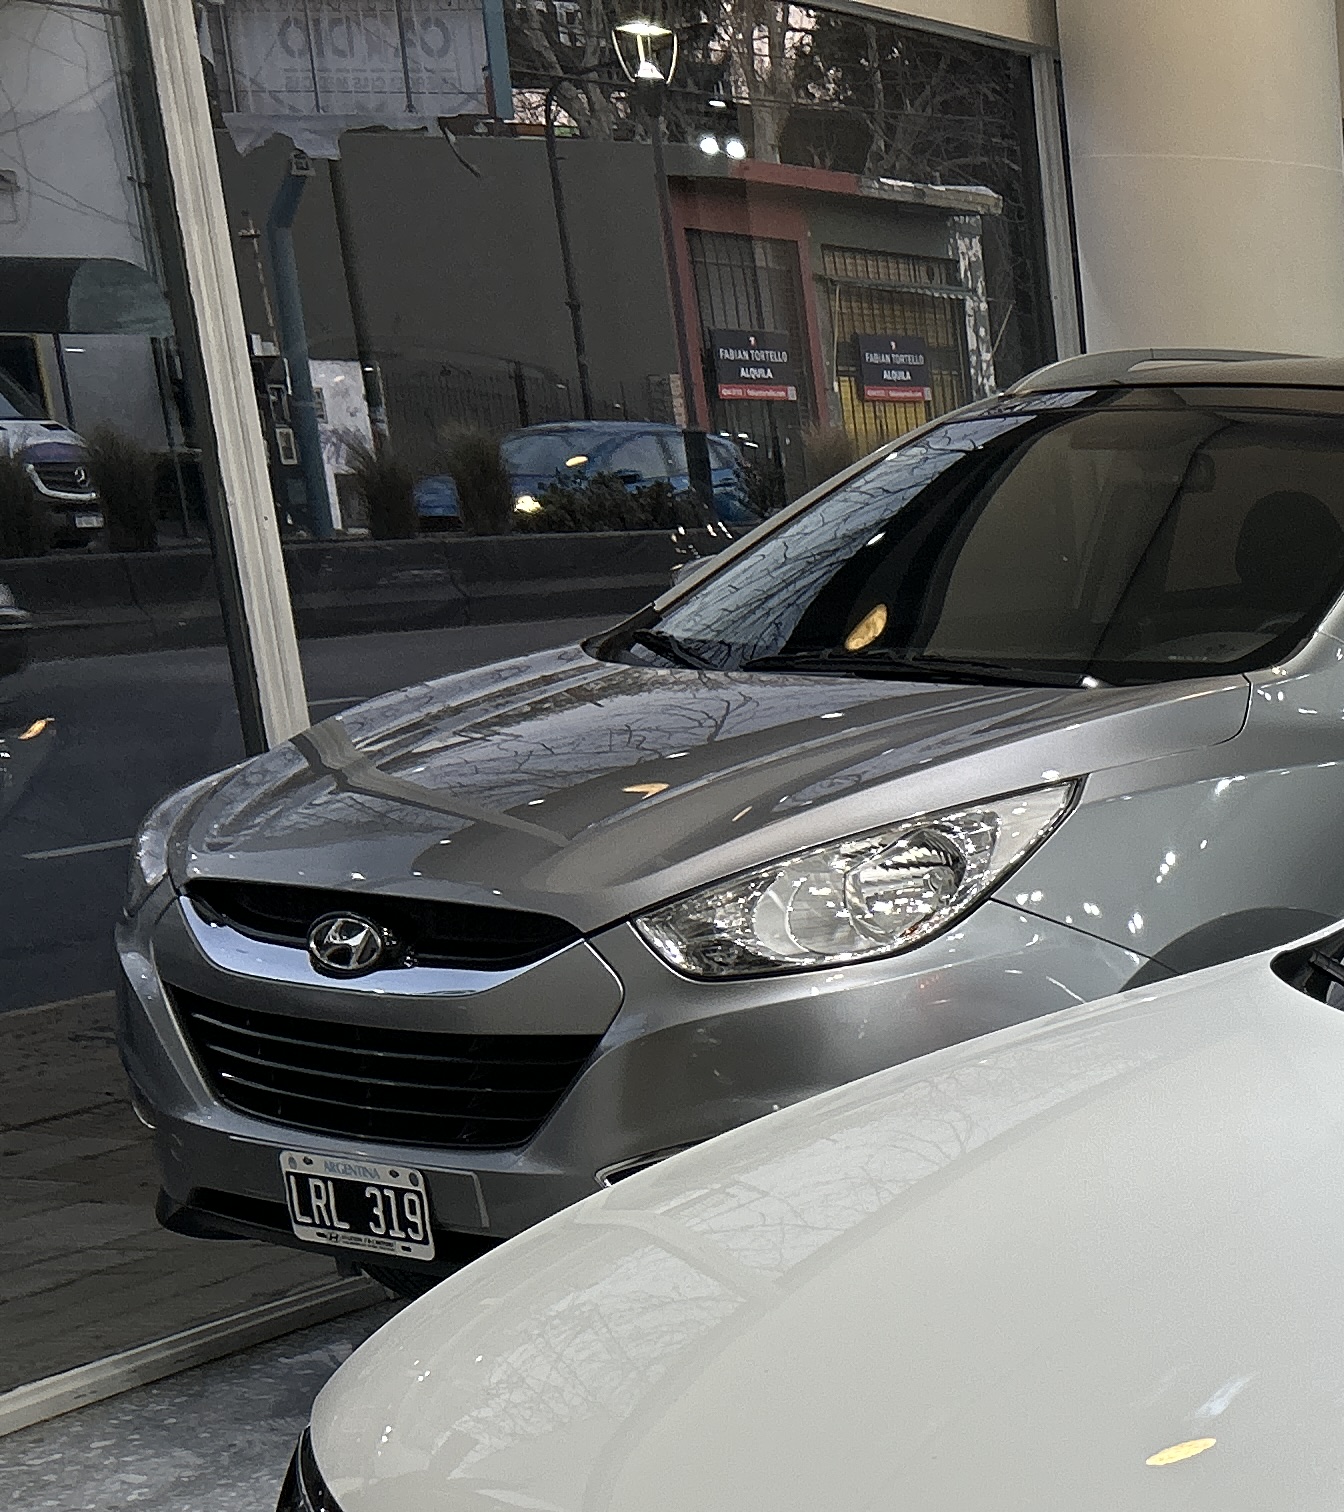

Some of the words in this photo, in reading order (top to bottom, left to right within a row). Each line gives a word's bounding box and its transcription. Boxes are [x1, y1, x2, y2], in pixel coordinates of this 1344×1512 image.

[719, 348, 749, 361] FABIAN
[750, 350, 788, 363] TORTELLO
[864, 352, 890, 364] FABIAN
[891, 353, 925, 365] TORTELLO
[740, 367, 773, 379] ALQUILA
[883, 369, 911, 382] ALQUILA
[324, 1160, 380, 1180] ARGENTINA
[289, 1174, 350, 1230] LRL
[365, 1186, 424, 1241] 319
